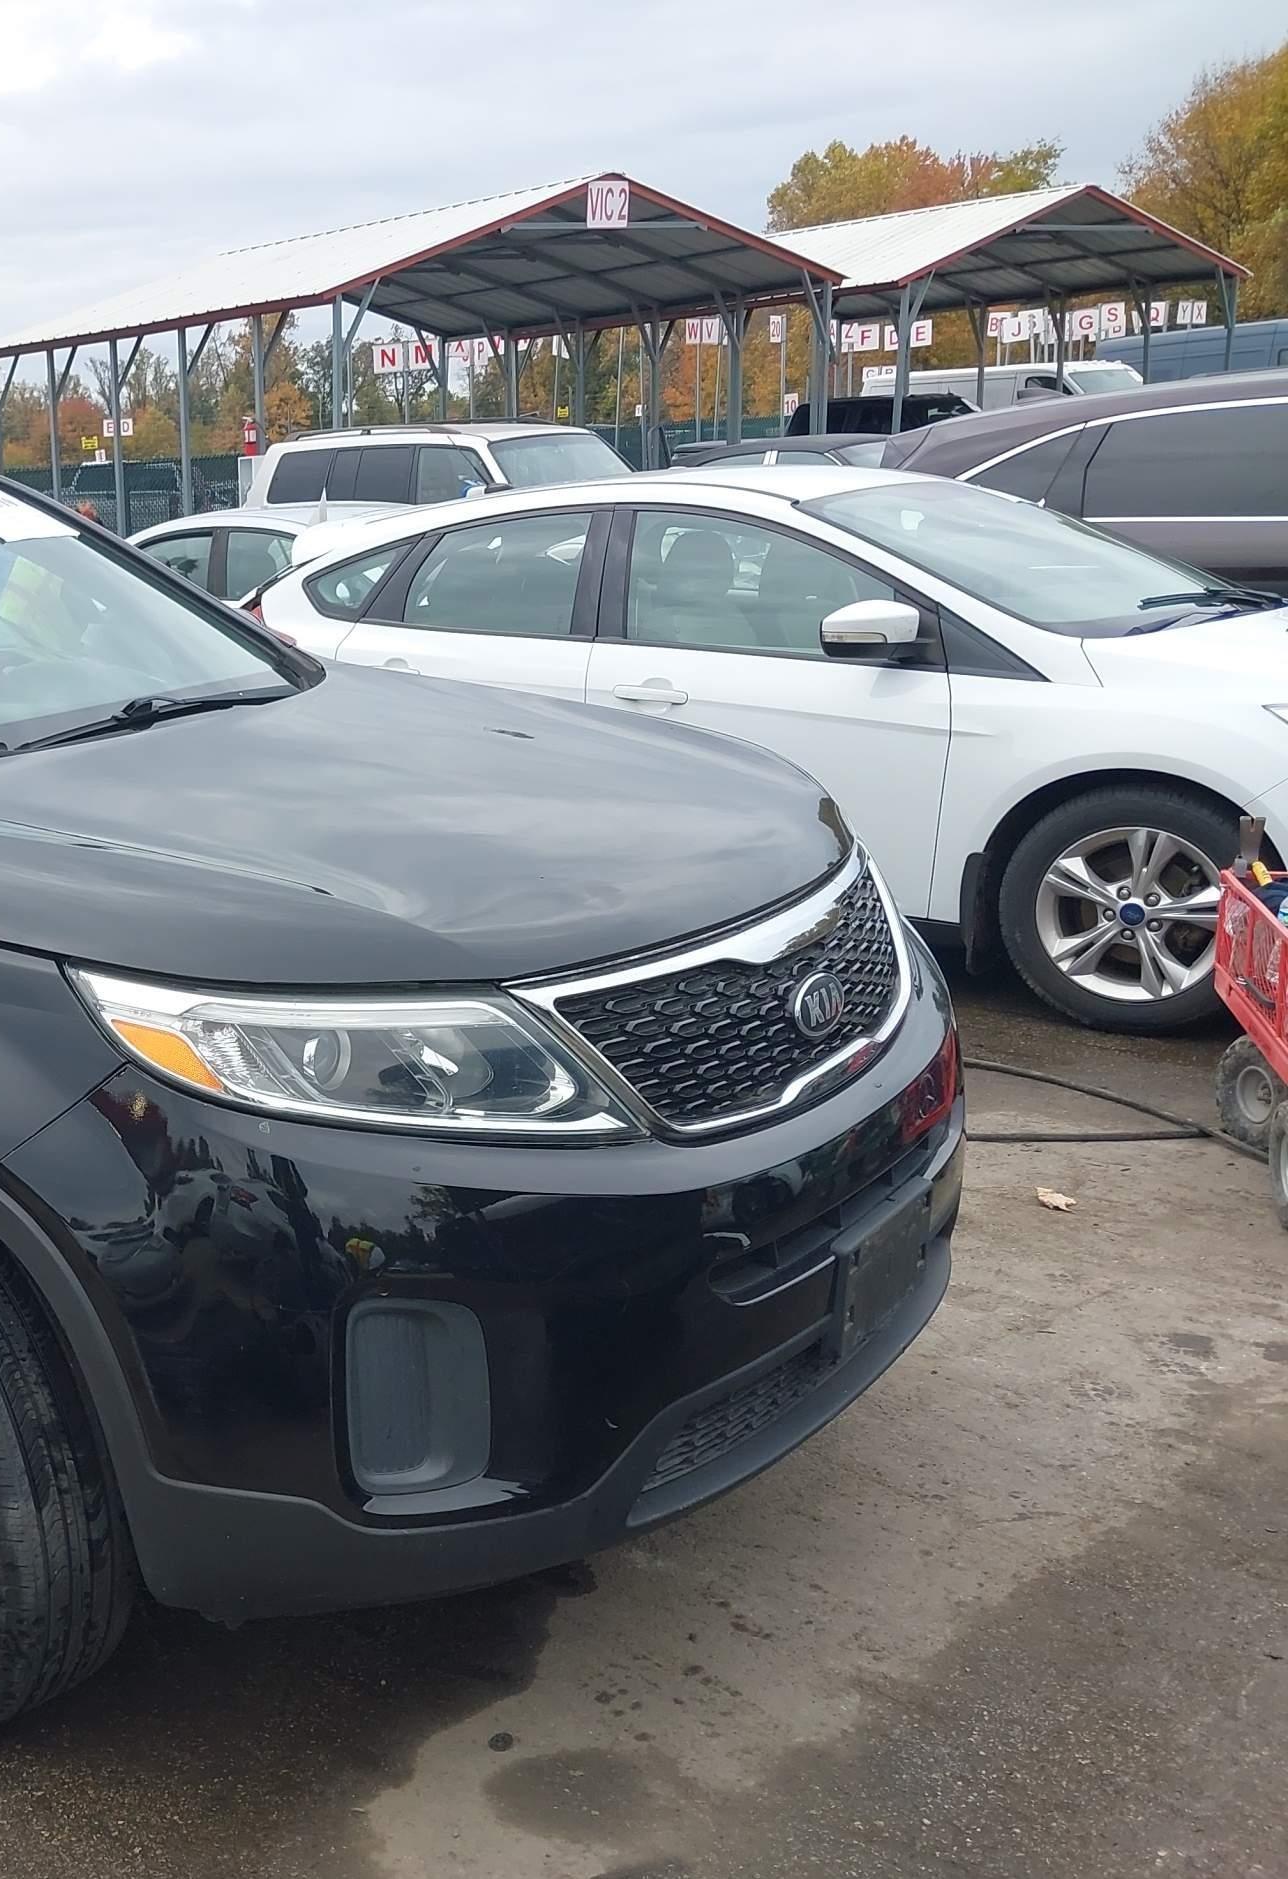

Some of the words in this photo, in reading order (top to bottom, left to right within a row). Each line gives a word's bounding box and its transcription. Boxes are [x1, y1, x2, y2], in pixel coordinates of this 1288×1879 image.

[589, 187, 614, 221] VIC
[617, 187, 628, 220] 2
[1107, 307, 1119, 322] S
[1182, 304, 1189, 320] Y
[1196, 304, 1204, 320] X
[688, 321, 699, 339] W
[705, 321, 714, 339] V
[771, 320, 781, 339] 20
[990, 317, 998, 331] B
[1011, 321, 1022, 337] J
[1079, 315, 1094, 330] G
[861, 329, 872, 346] F
[915, 326, 926, 341] E
[381, 347, 396, 368] N
[414, 344, 432, 364] M
[784, 399, 797, 414] 10
[122, 421, 129, 432] D
[804, 982, 841, 1028] KIA
